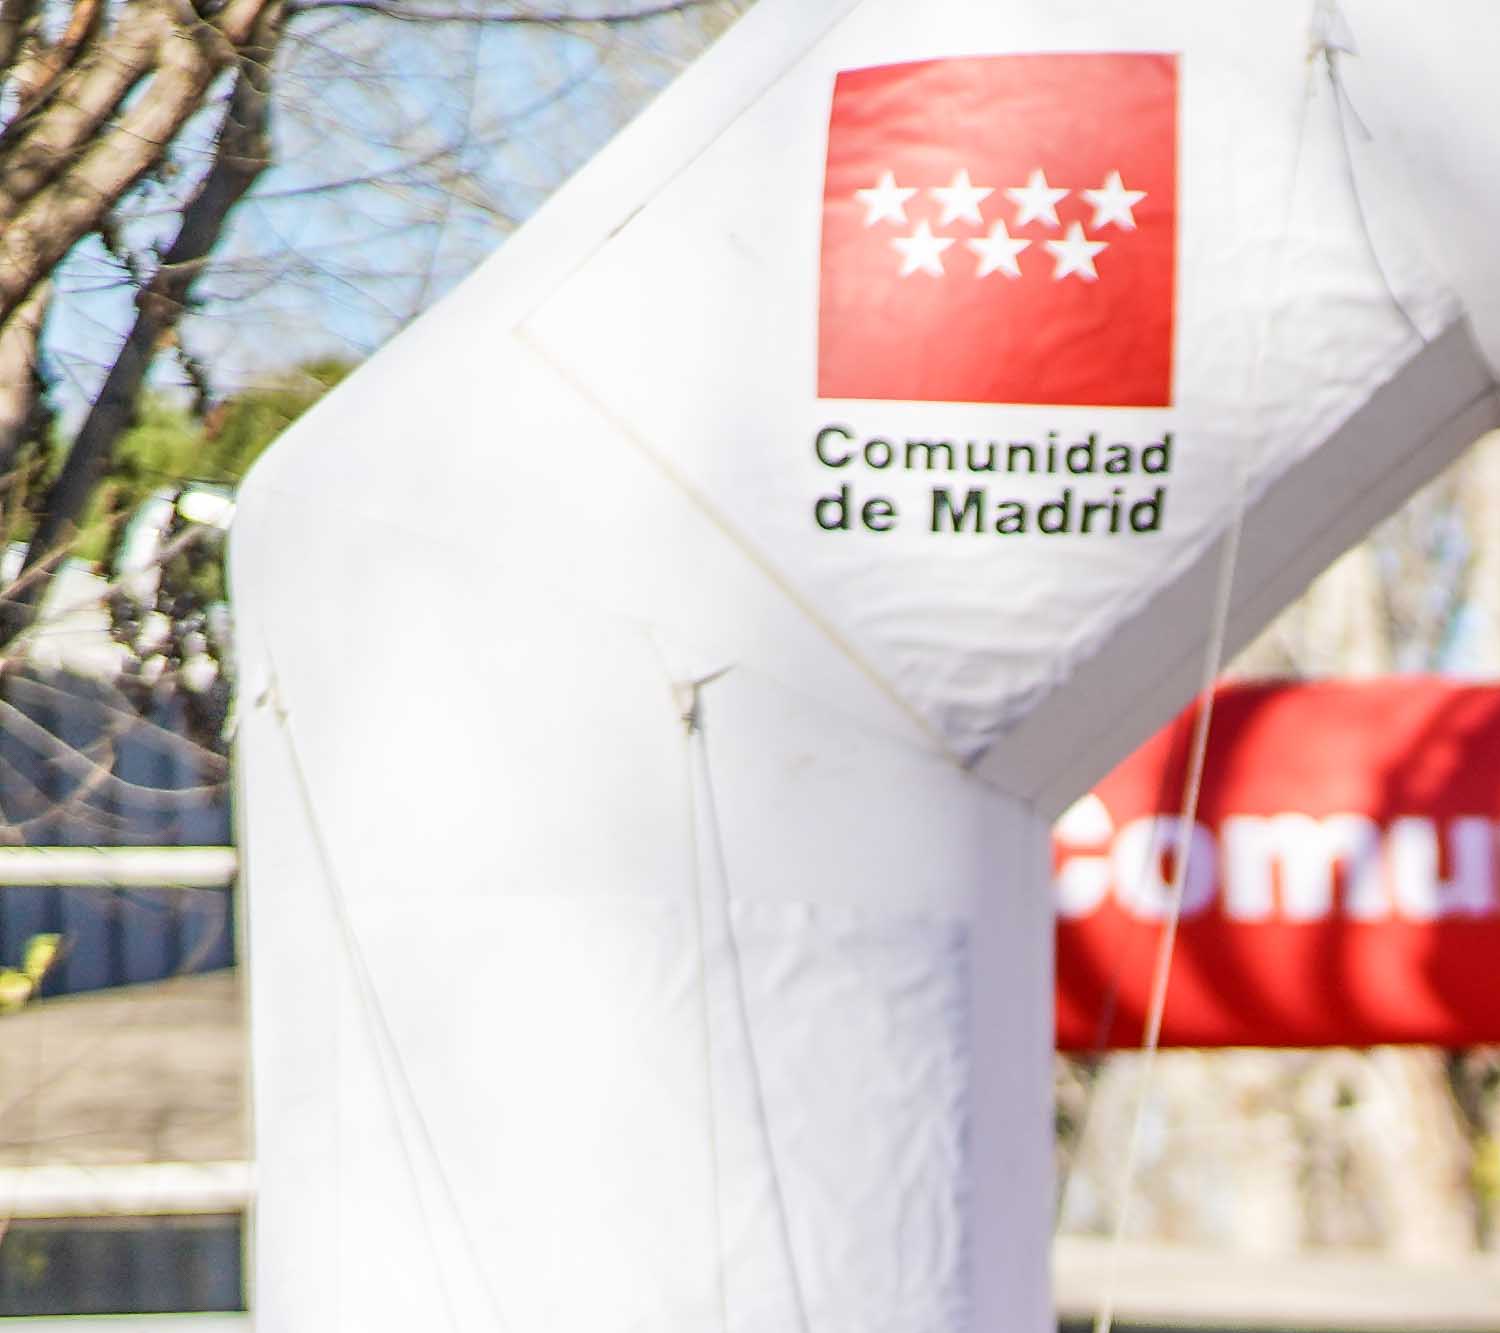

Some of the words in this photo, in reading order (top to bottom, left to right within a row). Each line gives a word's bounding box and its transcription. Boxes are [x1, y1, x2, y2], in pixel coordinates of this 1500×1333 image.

[814, 426, 1173, 475] Comunidad
[814, 484, 897, 532] de
[930, 488, 1166, 535] Madrid
